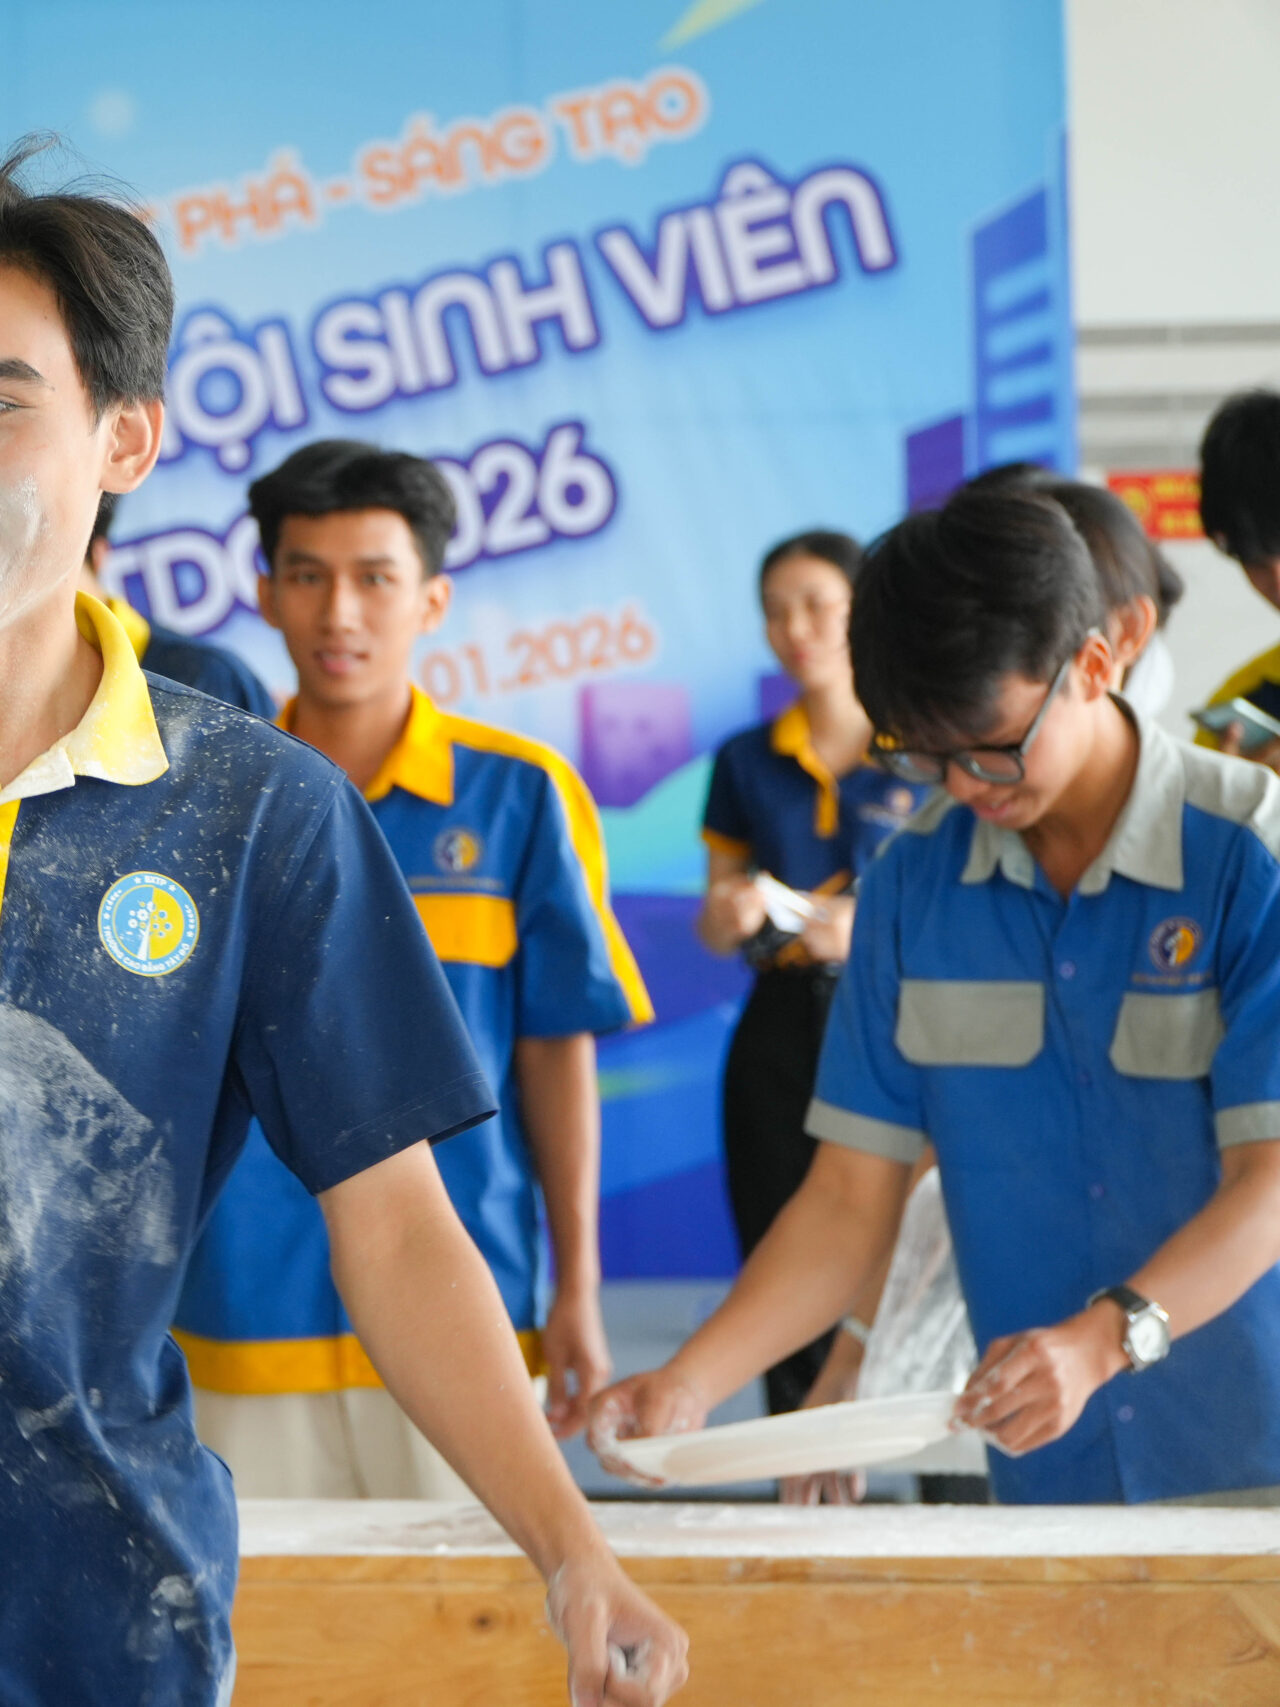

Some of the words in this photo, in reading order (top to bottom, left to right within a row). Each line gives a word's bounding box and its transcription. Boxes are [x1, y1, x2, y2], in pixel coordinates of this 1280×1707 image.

[359, 116, 548, 204] SÁNG
[552, 74, 702, 160] TẠO
[160, 312, 304, 472] ỘI
[315, 240, 599, 411] SINH
[594, 158, 895, 331] VIÊN
